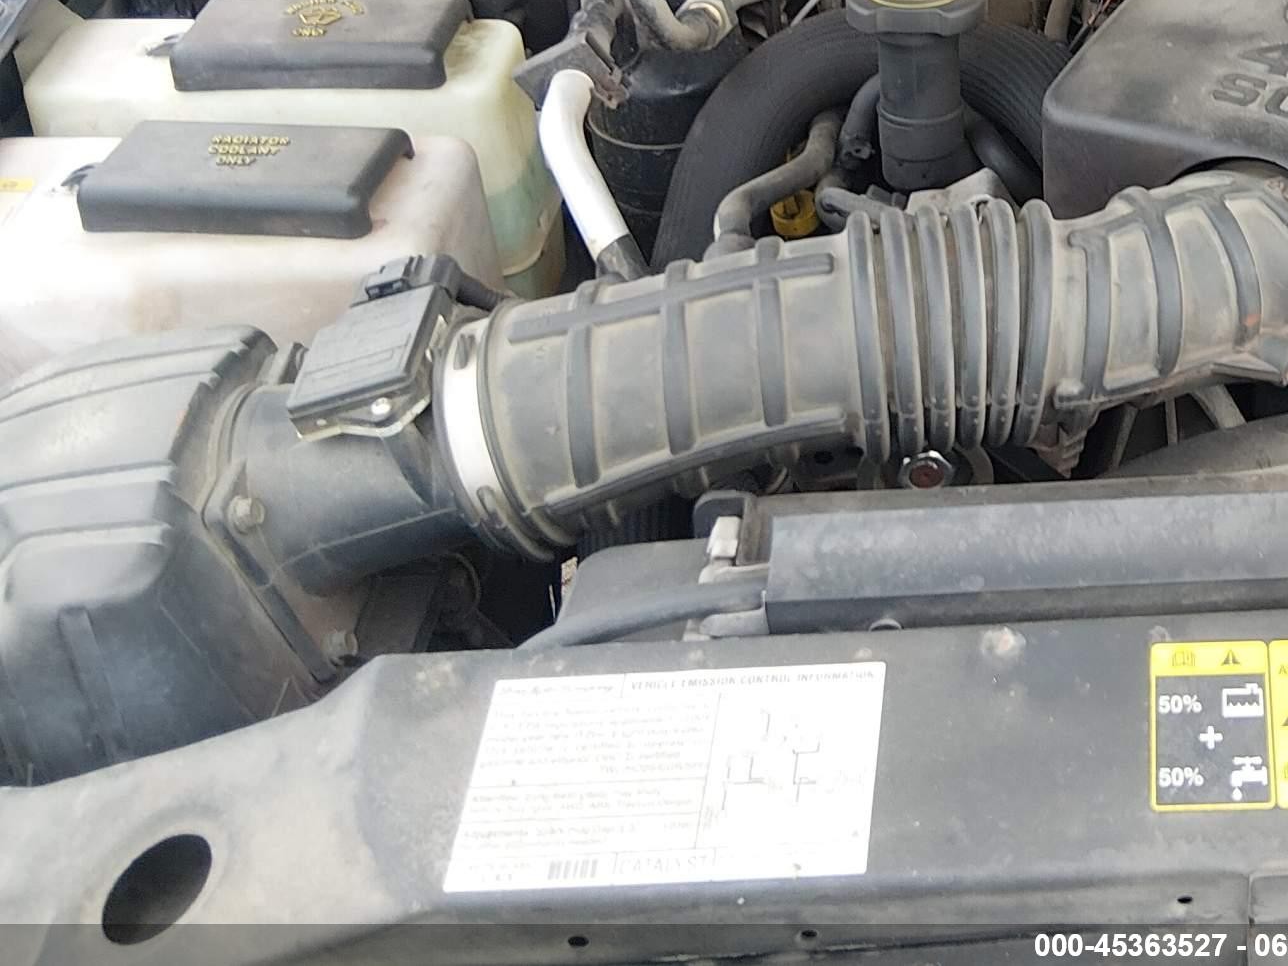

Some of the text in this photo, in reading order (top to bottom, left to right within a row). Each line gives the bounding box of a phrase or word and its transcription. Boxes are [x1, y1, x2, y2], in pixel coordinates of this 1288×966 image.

[212, 134, 290, 146] RADIATOR
[208, 144, 281, 155] COOLANT
[216, 155, 256, 165] ONLY
[681, 677, 736, 688] EMISSION
[740, 674, 792, 685] CONTROL
[1158, 695, 1202, 714] 50%
[1158, 767, 1204, 787] 50%
